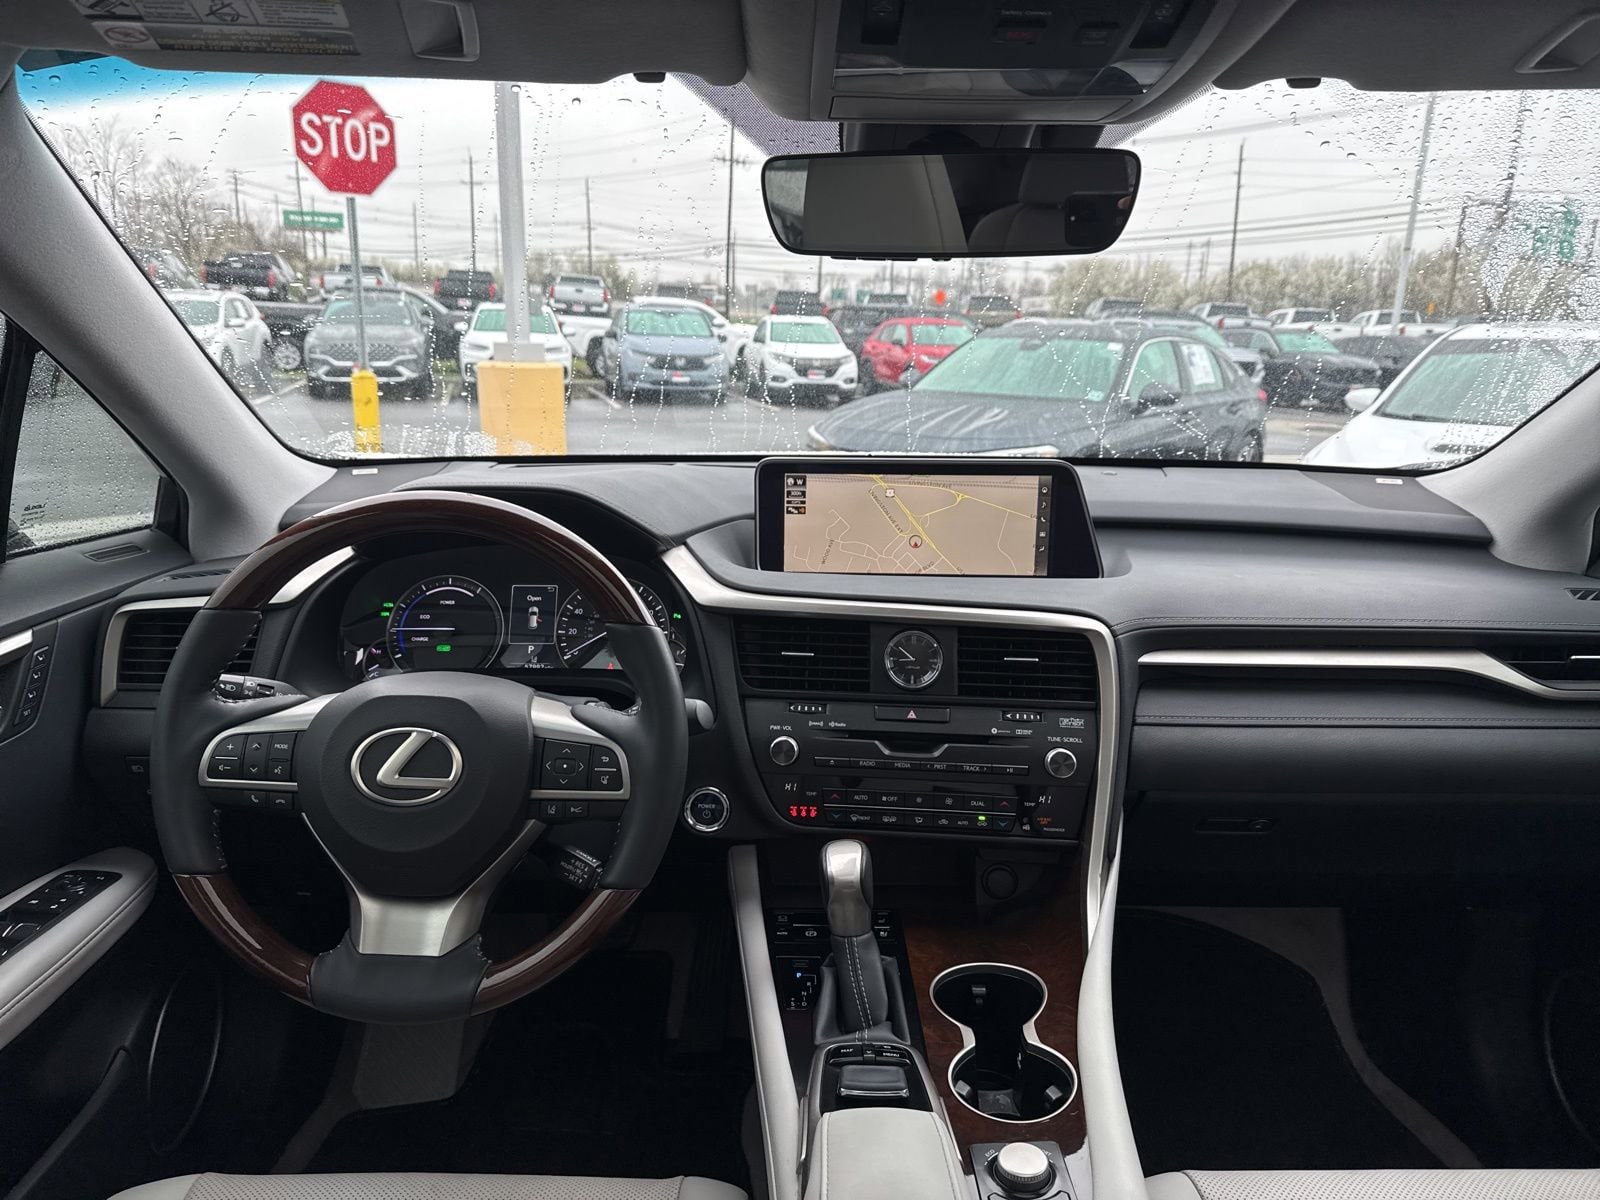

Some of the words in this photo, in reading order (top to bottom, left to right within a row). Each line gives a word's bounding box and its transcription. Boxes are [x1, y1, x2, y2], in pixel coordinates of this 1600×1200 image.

[300, 112, 391, 163] STOP
[526, 595, 542, 603] Open
[528, 645, 535, 654] P
[985, 1149, 995, 1158] ECO
